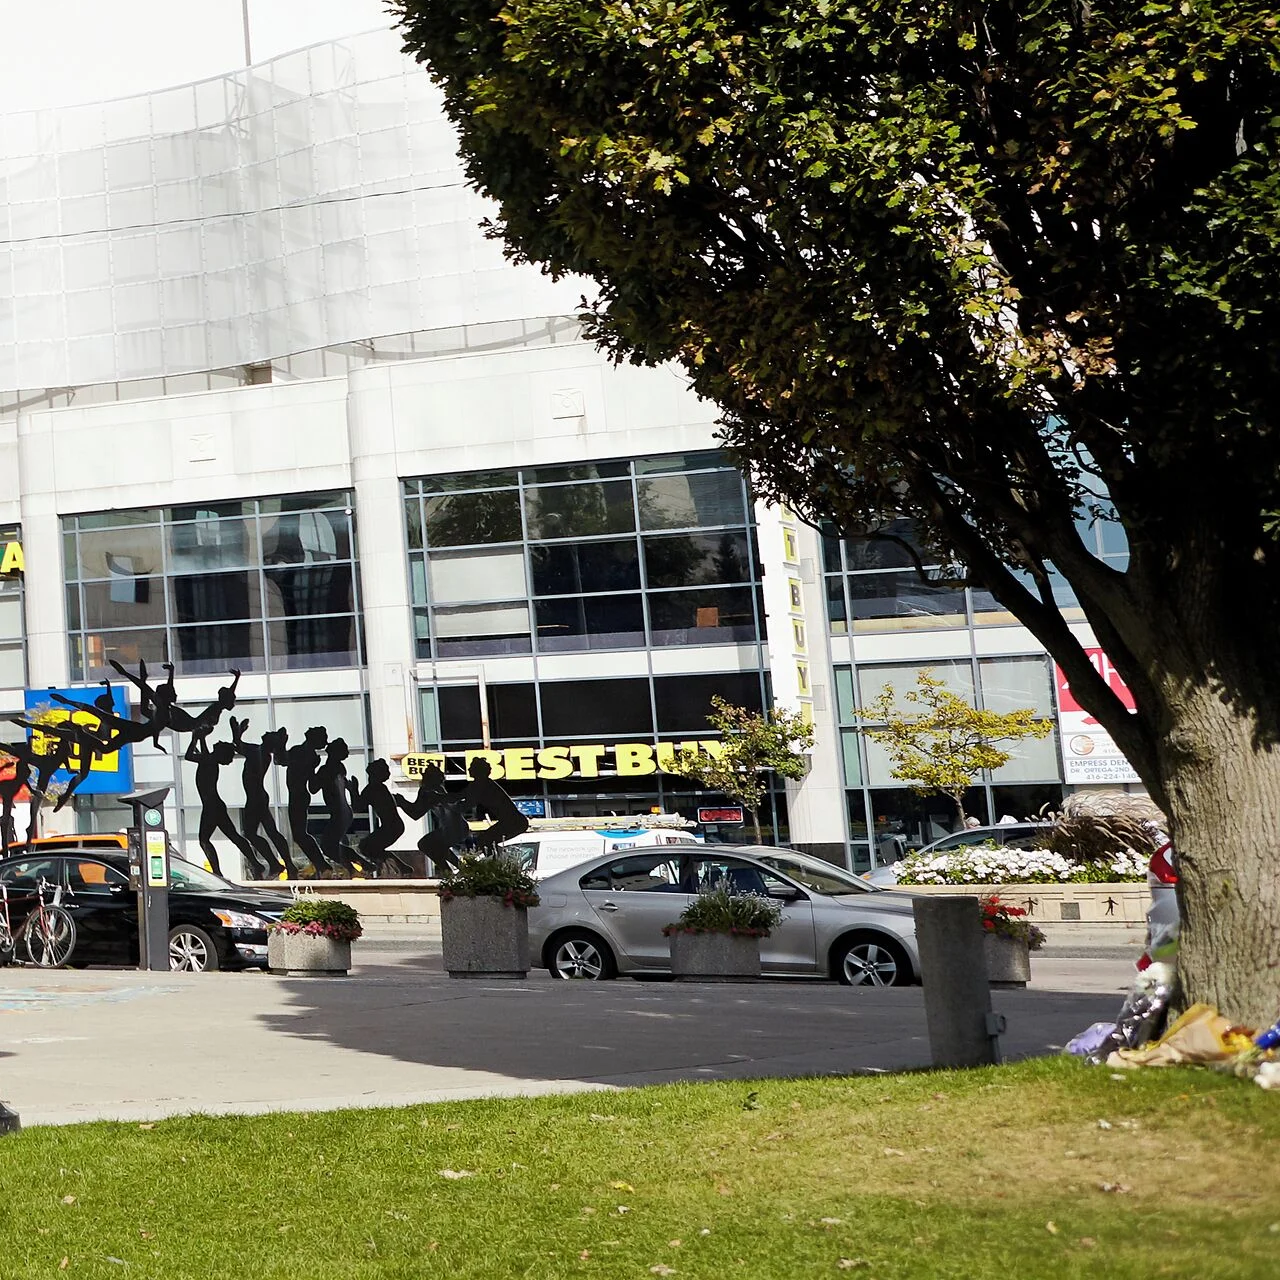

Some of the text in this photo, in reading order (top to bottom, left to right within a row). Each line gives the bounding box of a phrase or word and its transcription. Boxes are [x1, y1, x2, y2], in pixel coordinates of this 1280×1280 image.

[790, 583, 809, 689] BUY
[407, 757, 444, 768] BEST
[1070, 760, 1108, 768] EMPRESS
